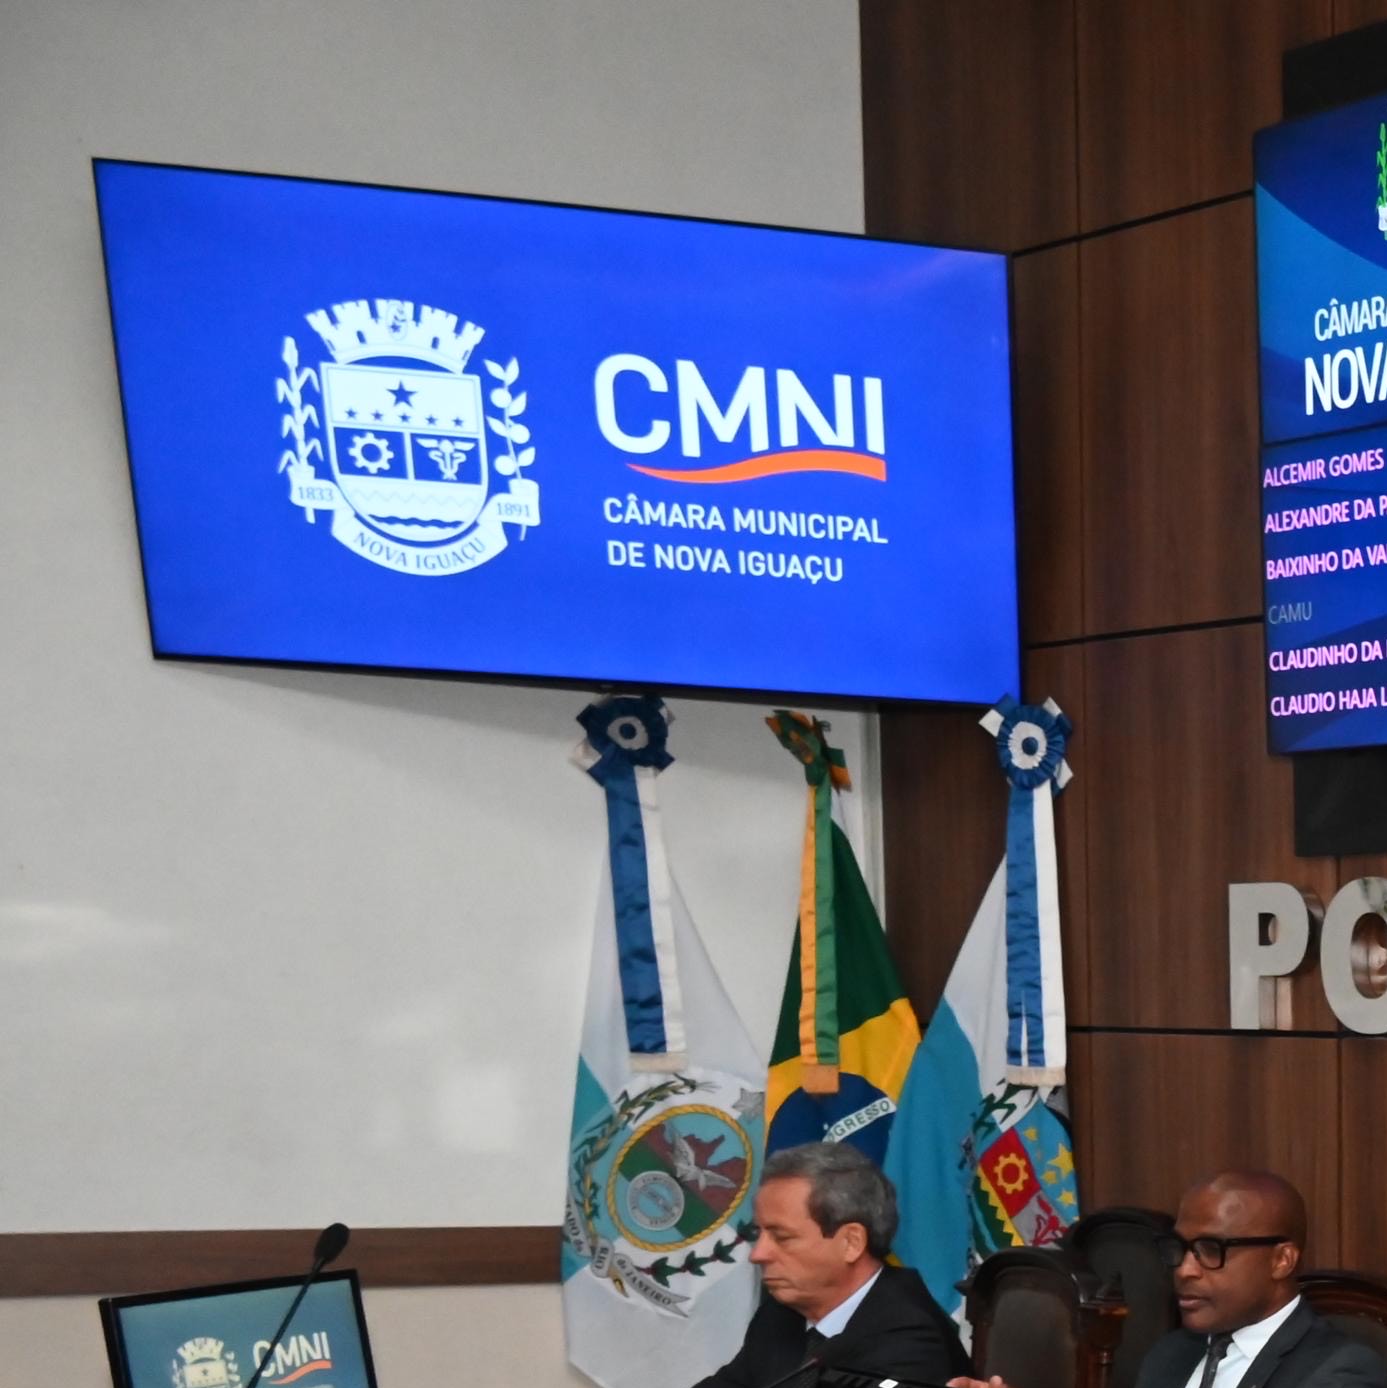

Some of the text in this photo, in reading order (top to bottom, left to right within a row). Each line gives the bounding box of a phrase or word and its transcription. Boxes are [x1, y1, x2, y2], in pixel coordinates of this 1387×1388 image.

[594, 353, 886, 457] CMNI
[1263, 448, 1384, 488] ALCEMIR GOMES
[496, 502, 531, 518] 1891
[603, 492, 889, 545] CÂMARA MUNICIPAL
[1264, 501, 1350, 533] ALEXANDRE
[1354, 498, 1376, 520] DA
[353, 532, 486, 570] NOVA IGUAÇU
[607, 541, 844, 585] DE NOVA IGUAÇU
[1266, 550, 1339, 580] BAIXINHO
[1342, 548, 1364, 570] DA
[1268, 602, 1312, 625] CAMU
[1269, 643, 1357, 672] CLAUDINHO
[1361, 640, 1383, 662] DA
[1270, 692, 1335, 717] CLAUDIO
[1339, 687, 1377, 710] HAJA
[253, 1332, 331, 1377] CMNI
